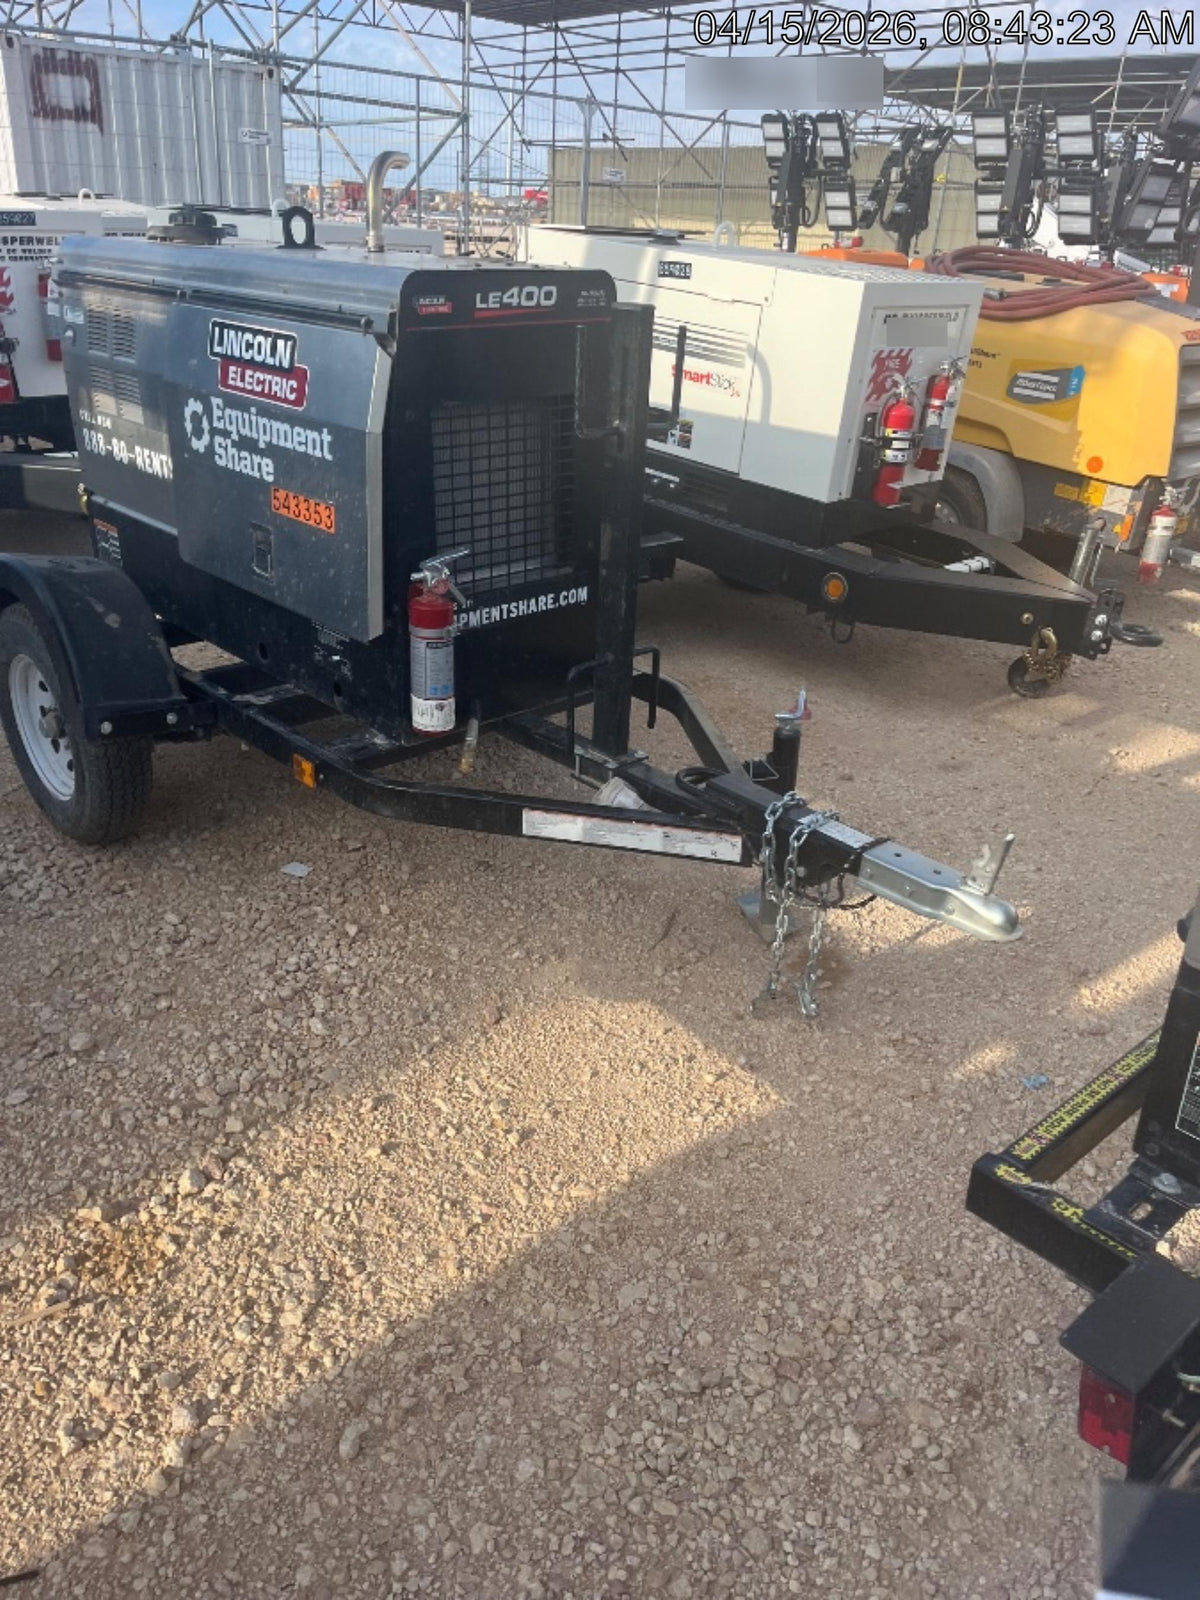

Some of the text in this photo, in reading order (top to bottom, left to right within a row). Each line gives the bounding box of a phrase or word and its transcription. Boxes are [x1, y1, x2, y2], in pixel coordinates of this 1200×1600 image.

[475, 285, 557, 308] LE400
[213, 326, 294, 369] LINCOLN
[228, 365, 298, 401] ELECTRIC
[210, 396, 333, 461] Equipment
[214, 435, 275, 482] Share
[273, 488, 334, 530] 543353
